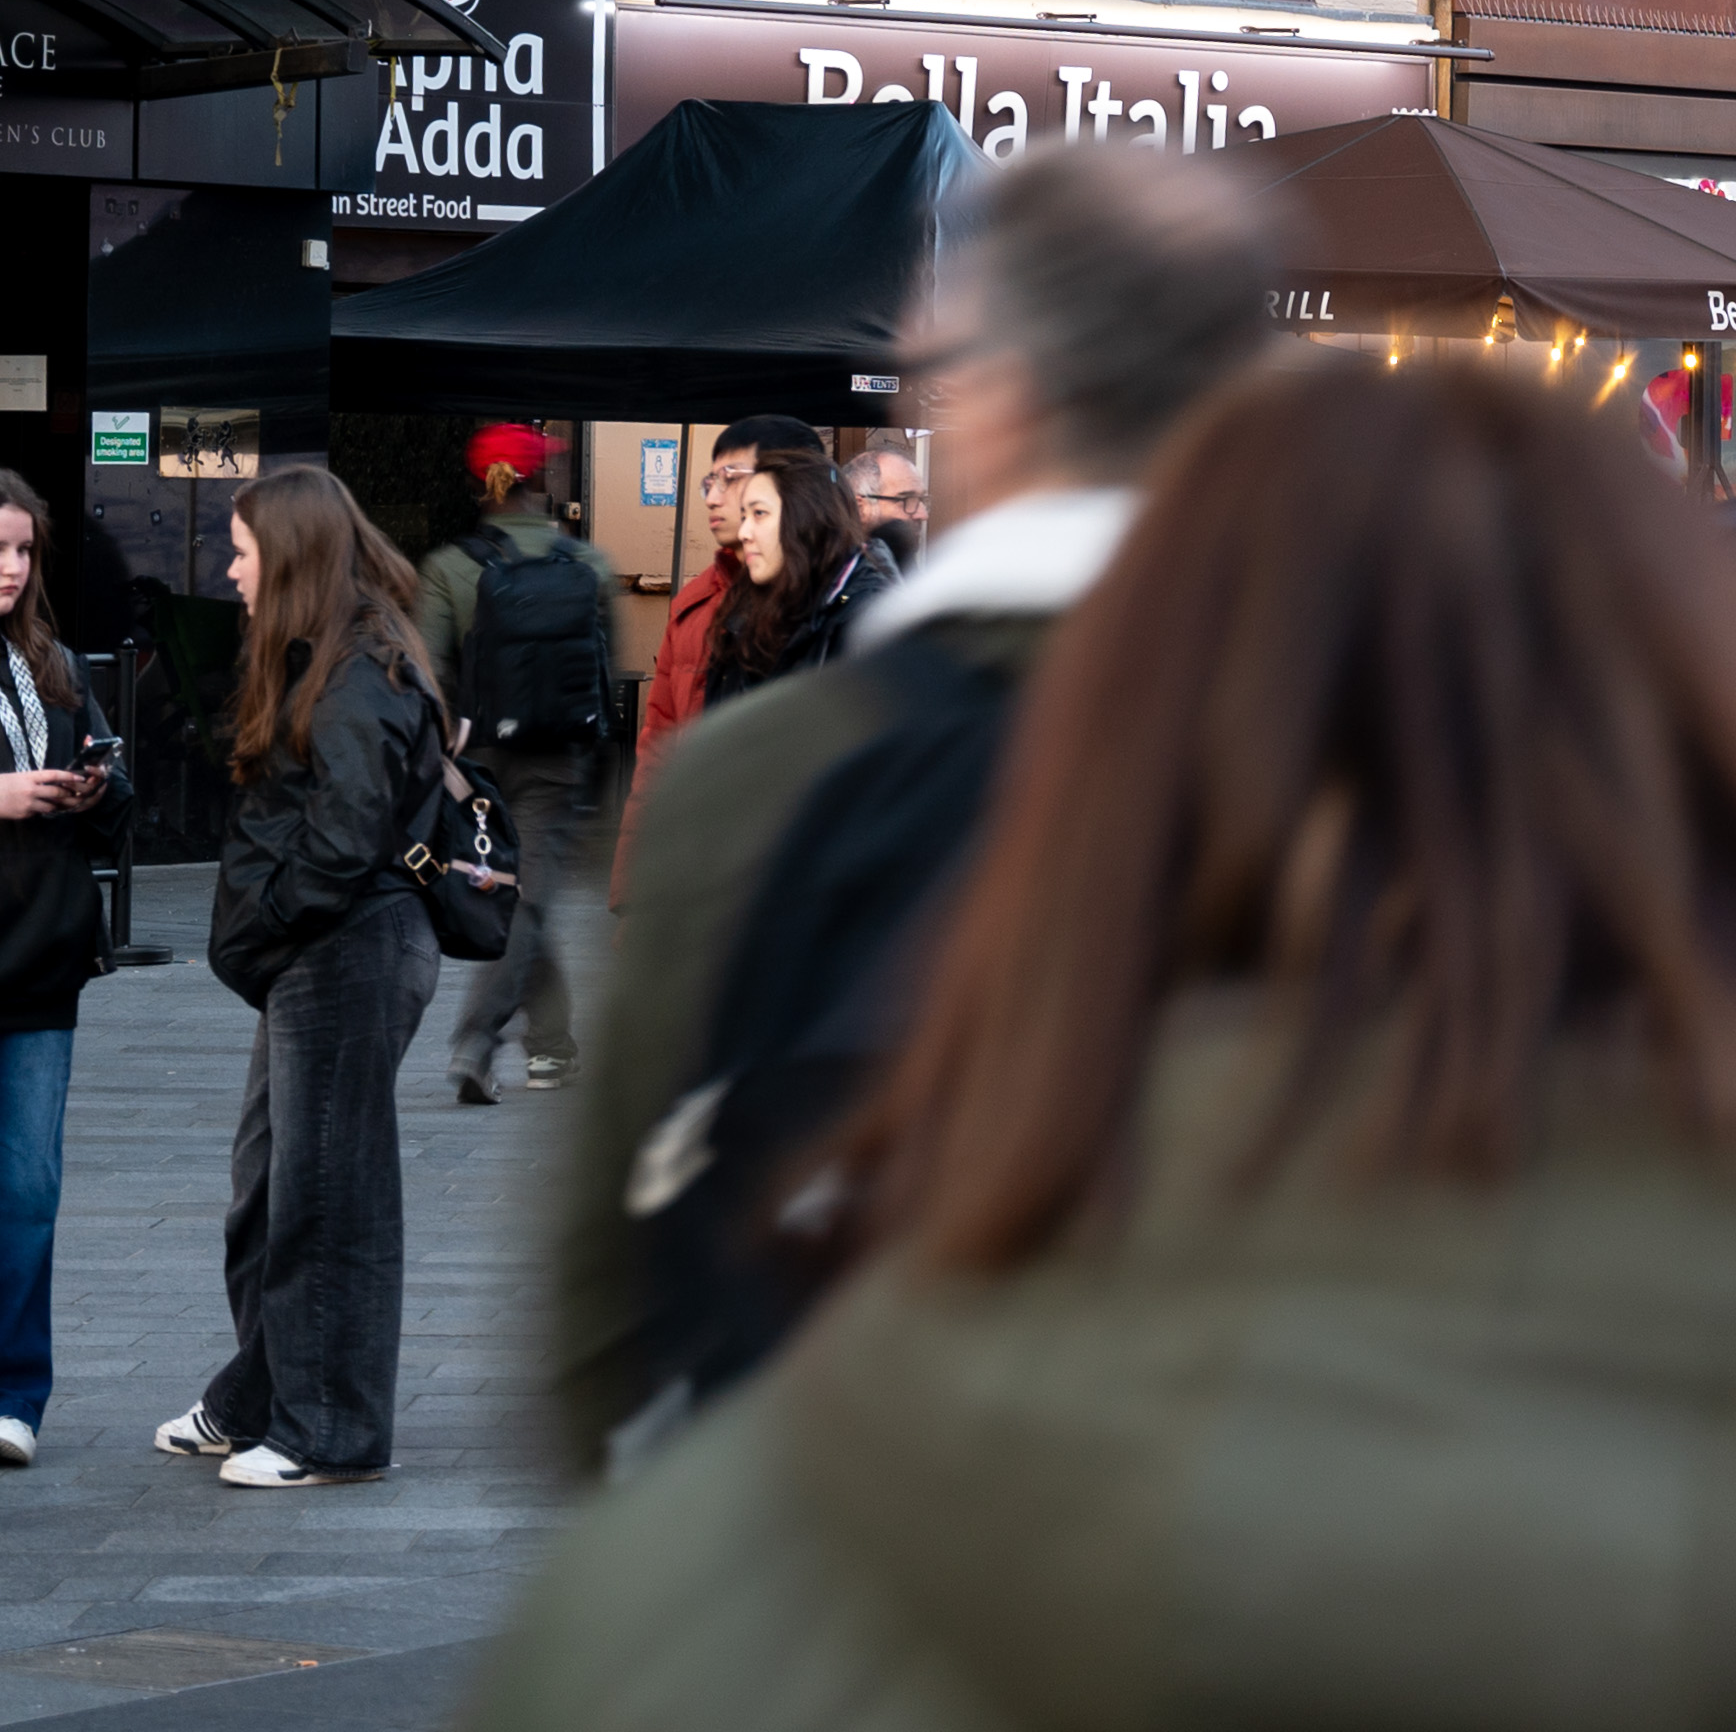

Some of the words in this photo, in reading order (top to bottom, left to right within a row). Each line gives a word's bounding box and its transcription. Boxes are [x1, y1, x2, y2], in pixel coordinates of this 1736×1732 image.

[51, 126, 106, 149] CLUB
[375, 101, 544, 180] Adda
[356, 193, 418, 217] Street
[422, 194, 472, 219] Food
[871, 379, 897, 390] TENTS
[100, 436, 142, 448] Designated
[96, 447, 128, 458] smoking
